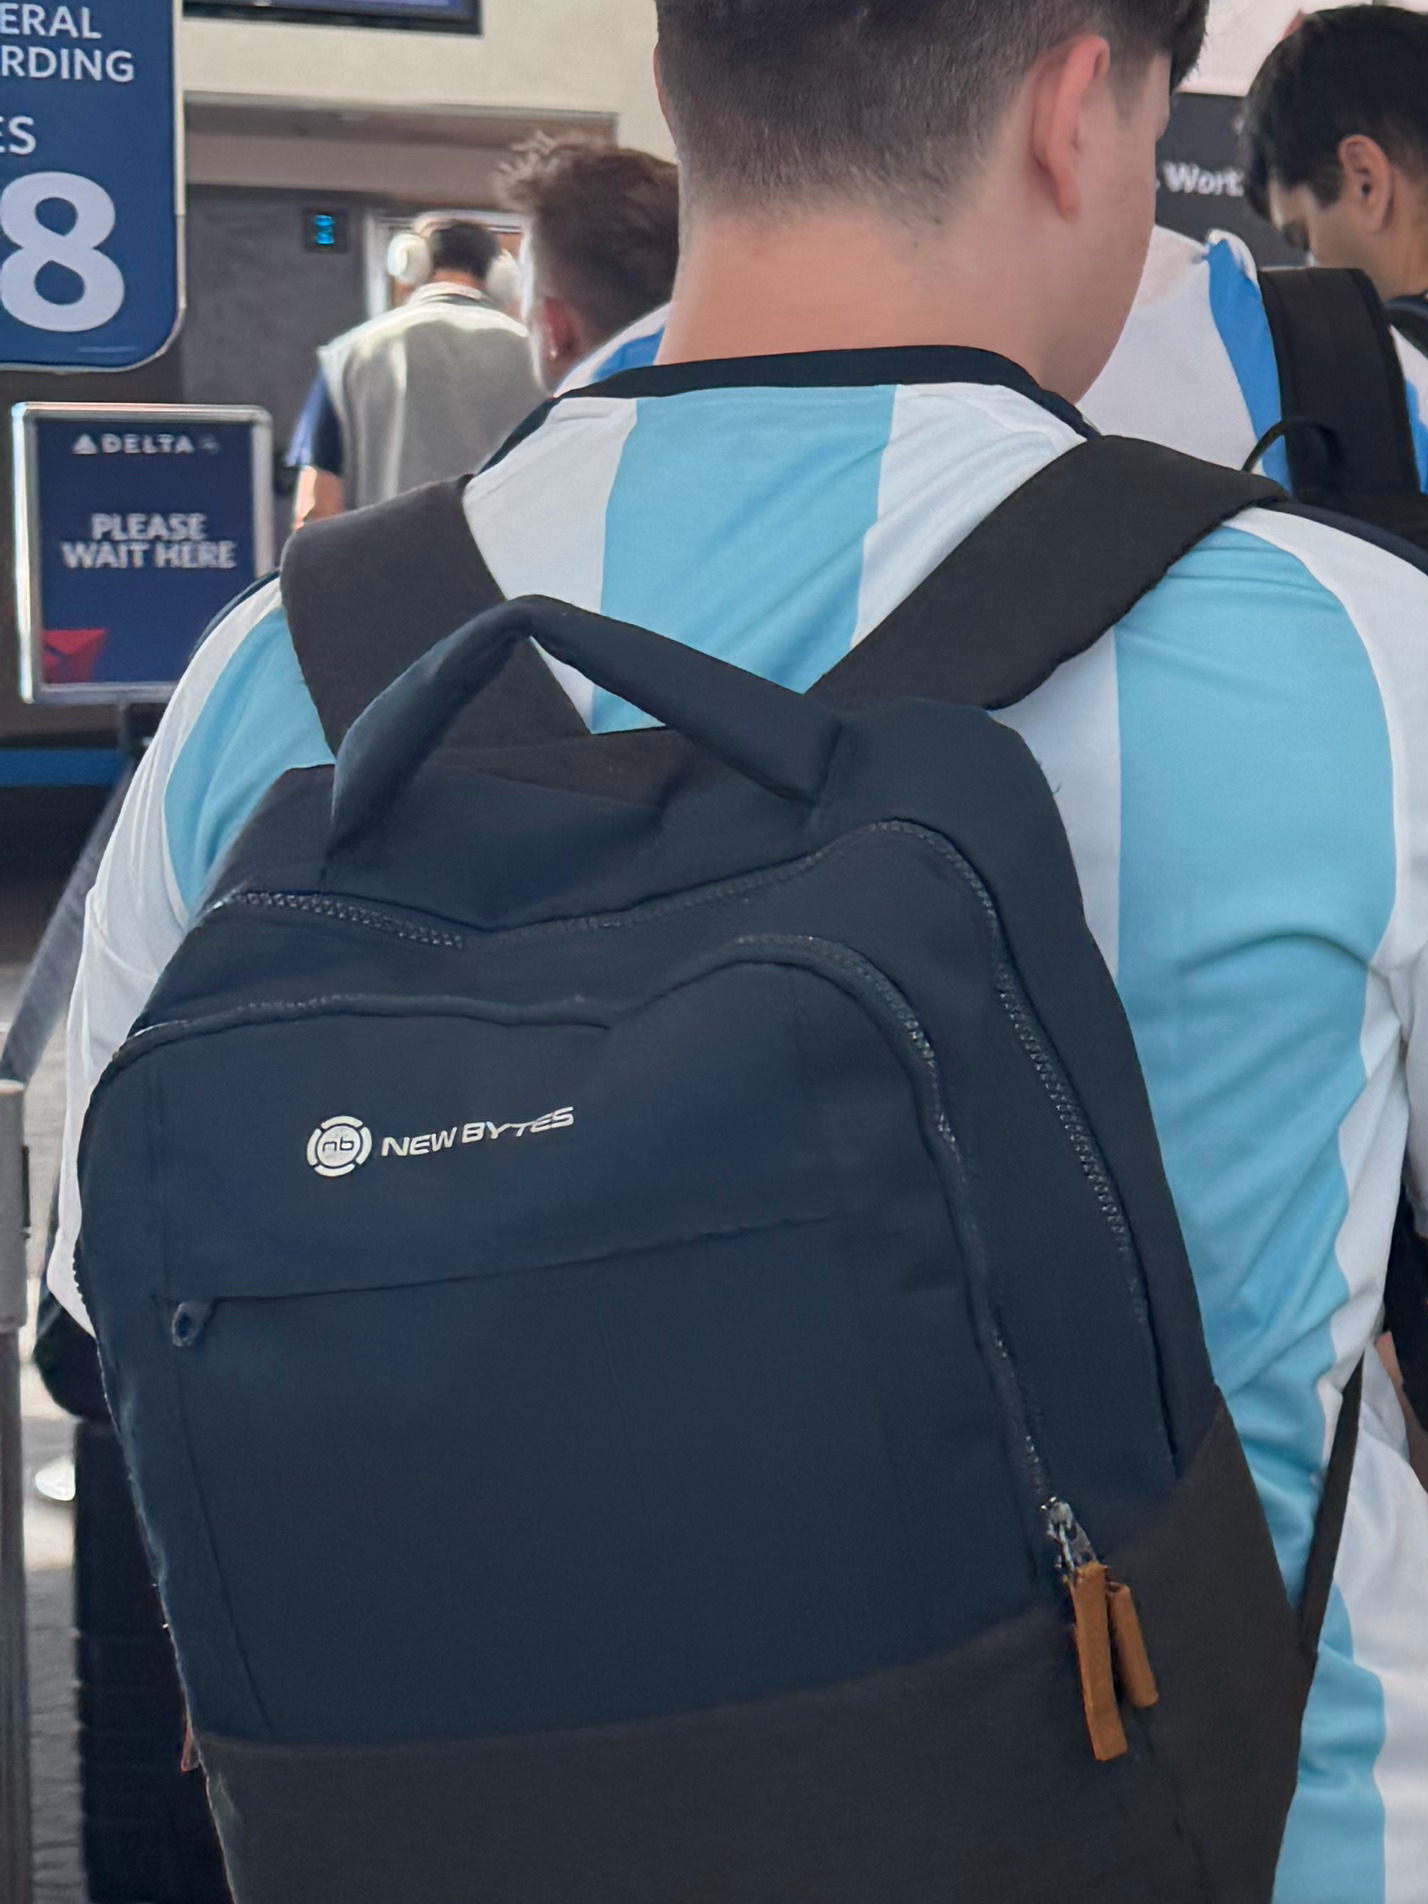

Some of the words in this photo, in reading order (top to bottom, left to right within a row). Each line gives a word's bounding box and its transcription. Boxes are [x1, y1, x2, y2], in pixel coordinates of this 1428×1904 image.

[0, 170, 125, 333] 8
[101, 433, 195, 455] DELTA
[91, 512, 208, 542] PLEASE
[61, 541, 150, 569] WAIT
[153, 540, 238, 570] HERE
